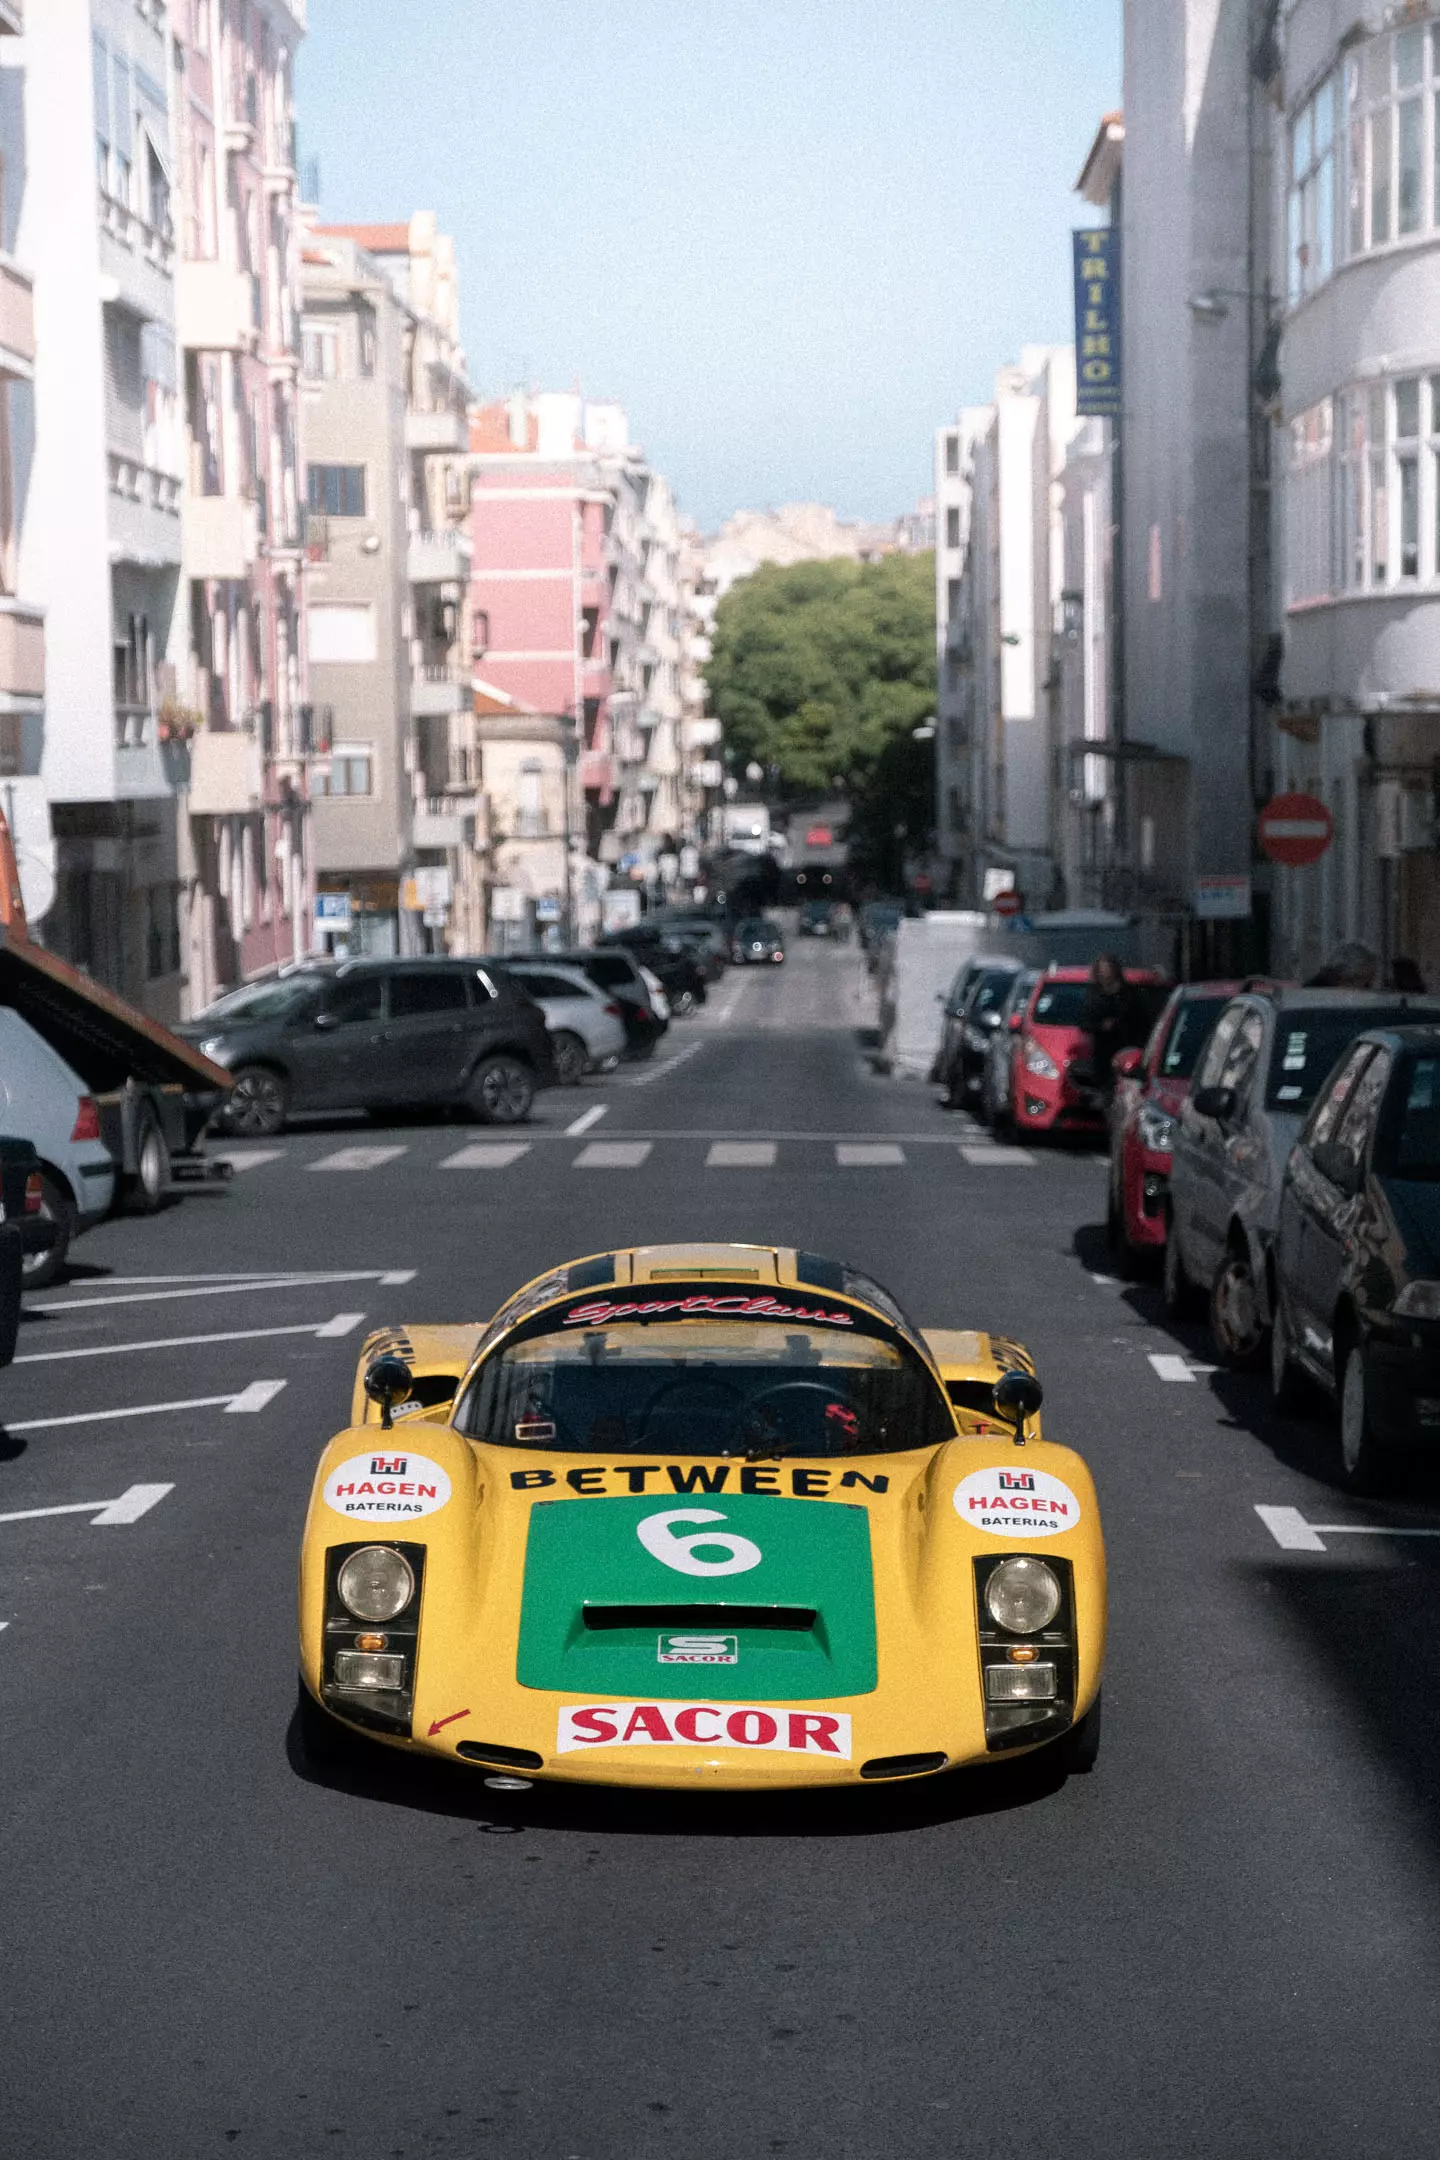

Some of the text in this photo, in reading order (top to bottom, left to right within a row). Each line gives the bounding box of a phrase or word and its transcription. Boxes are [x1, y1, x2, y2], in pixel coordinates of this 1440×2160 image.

[1079, 231, 1111, 381] TRILHO
[336, 1481, 437, 1498] HAGEN
[510, 1465, 889, 1497] BETWEEN
[345, 1502, 423, 1513] BATERIAS
[968, 1496, 1068, 1515] HAGEN
[981, 1517, 1058, 1529] BATERIAS
[636, 1508, 762, 1577] 6
[662, 1655, 732, 1663] SACOR
[571, 1706, 841, 1753] SACOR
